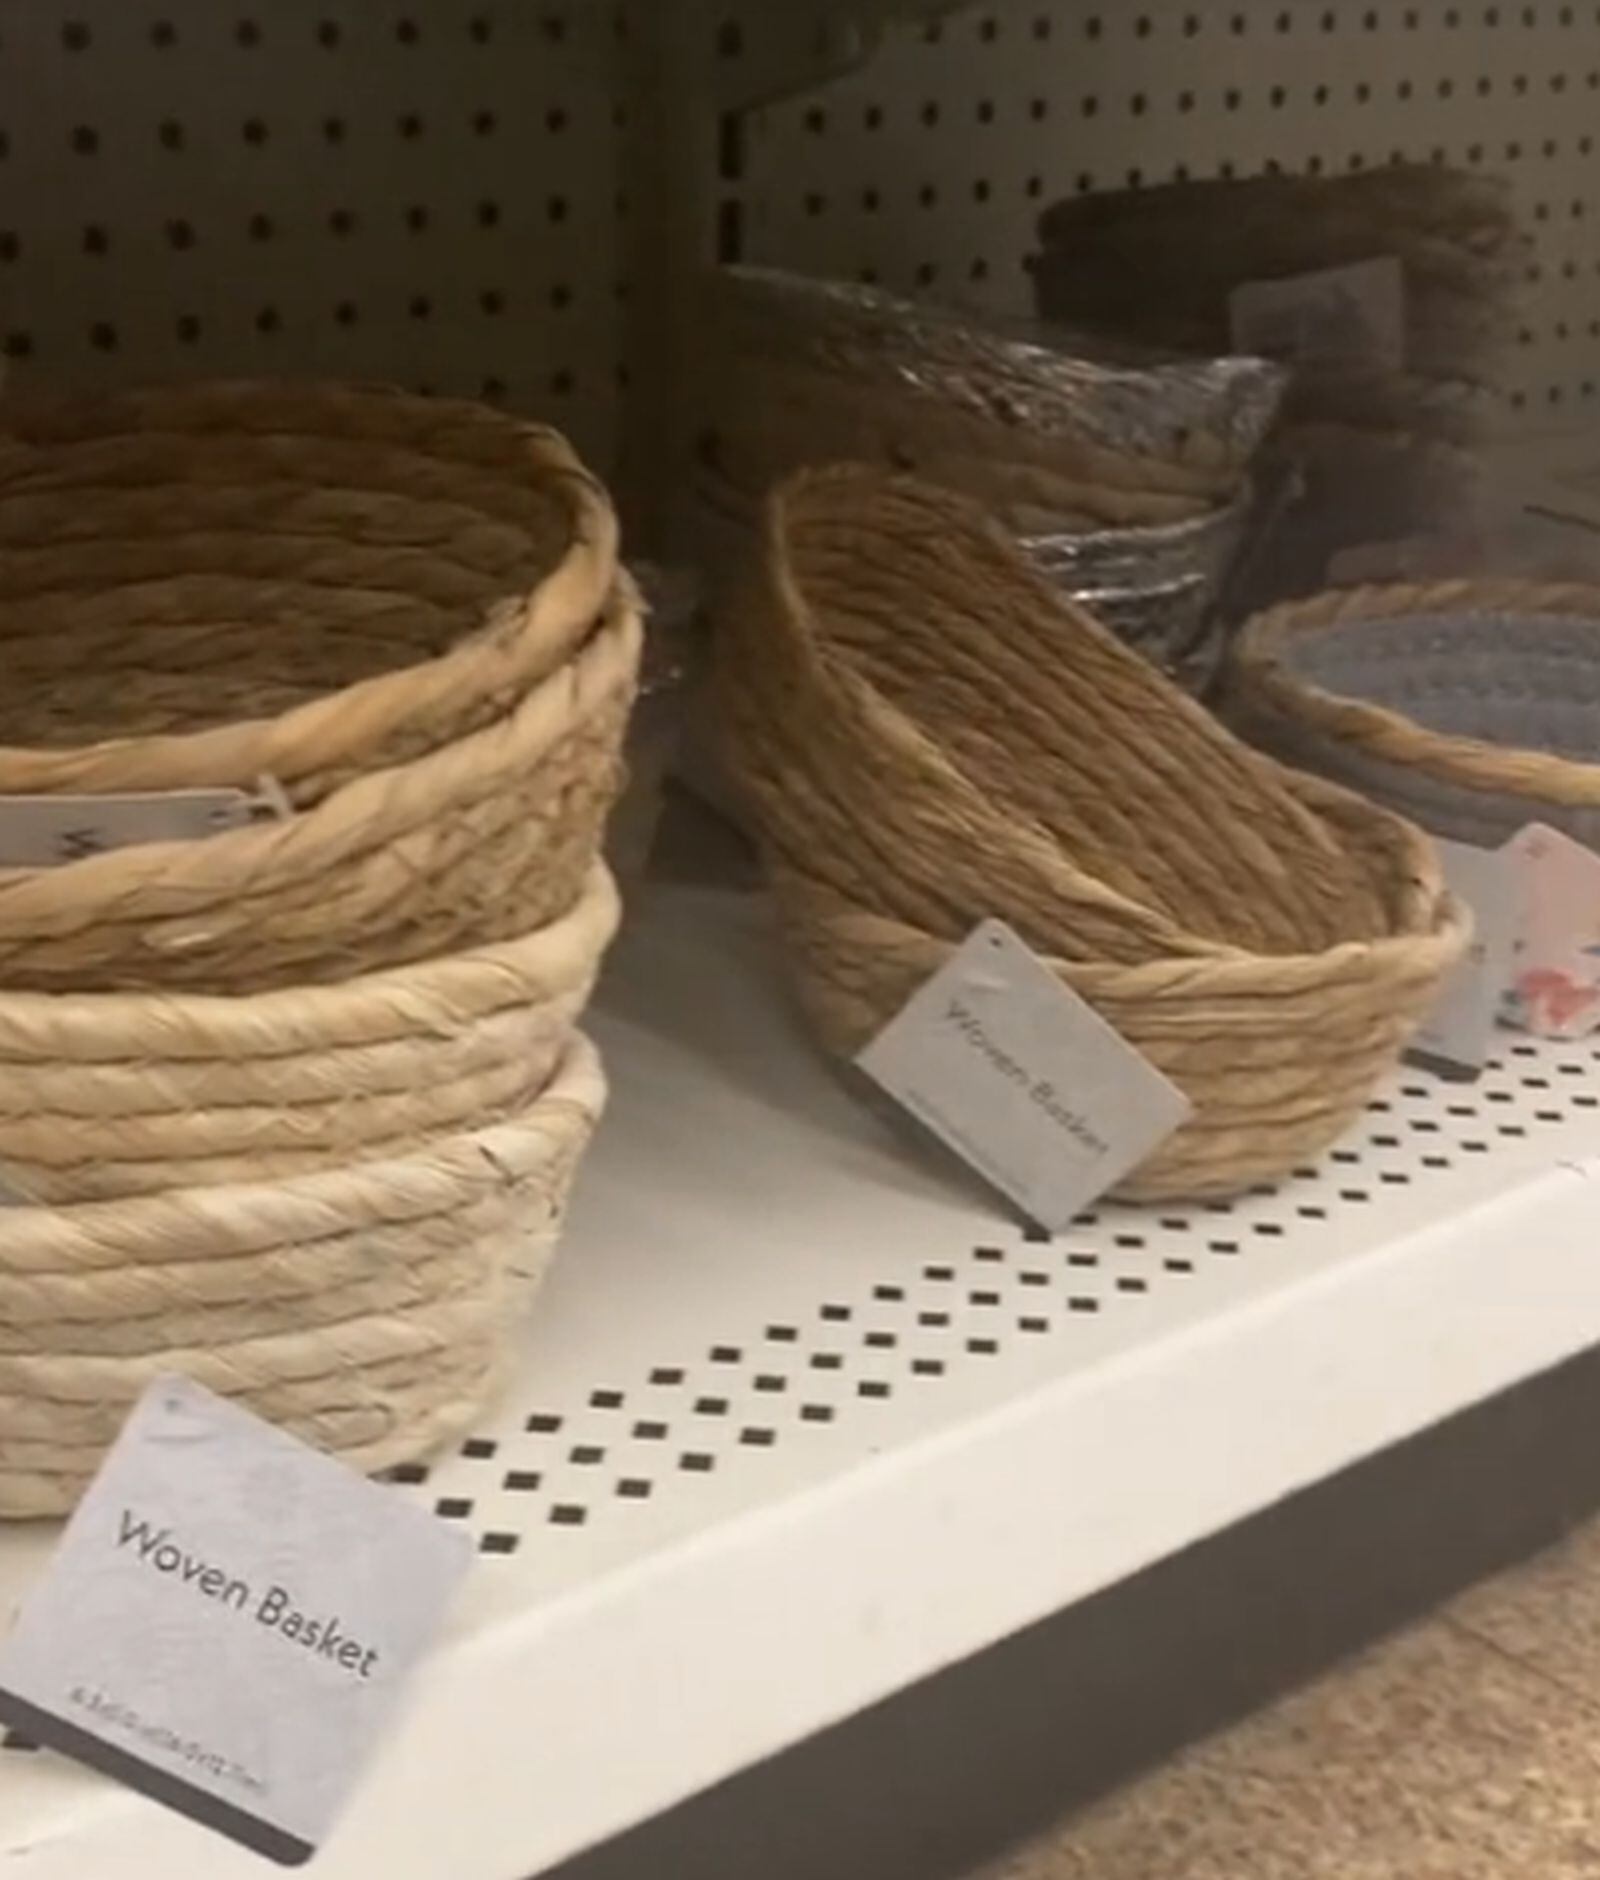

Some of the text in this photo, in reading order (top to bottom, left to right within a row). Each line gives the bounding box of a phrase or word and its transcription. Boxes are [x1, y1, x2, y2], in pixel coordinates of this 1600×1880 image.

[946, 1001, 1029, 1086] Woven
[1029, 1081, 1110, 1154] Basket
[117, 1508, 379, 1678] Woven Basket
